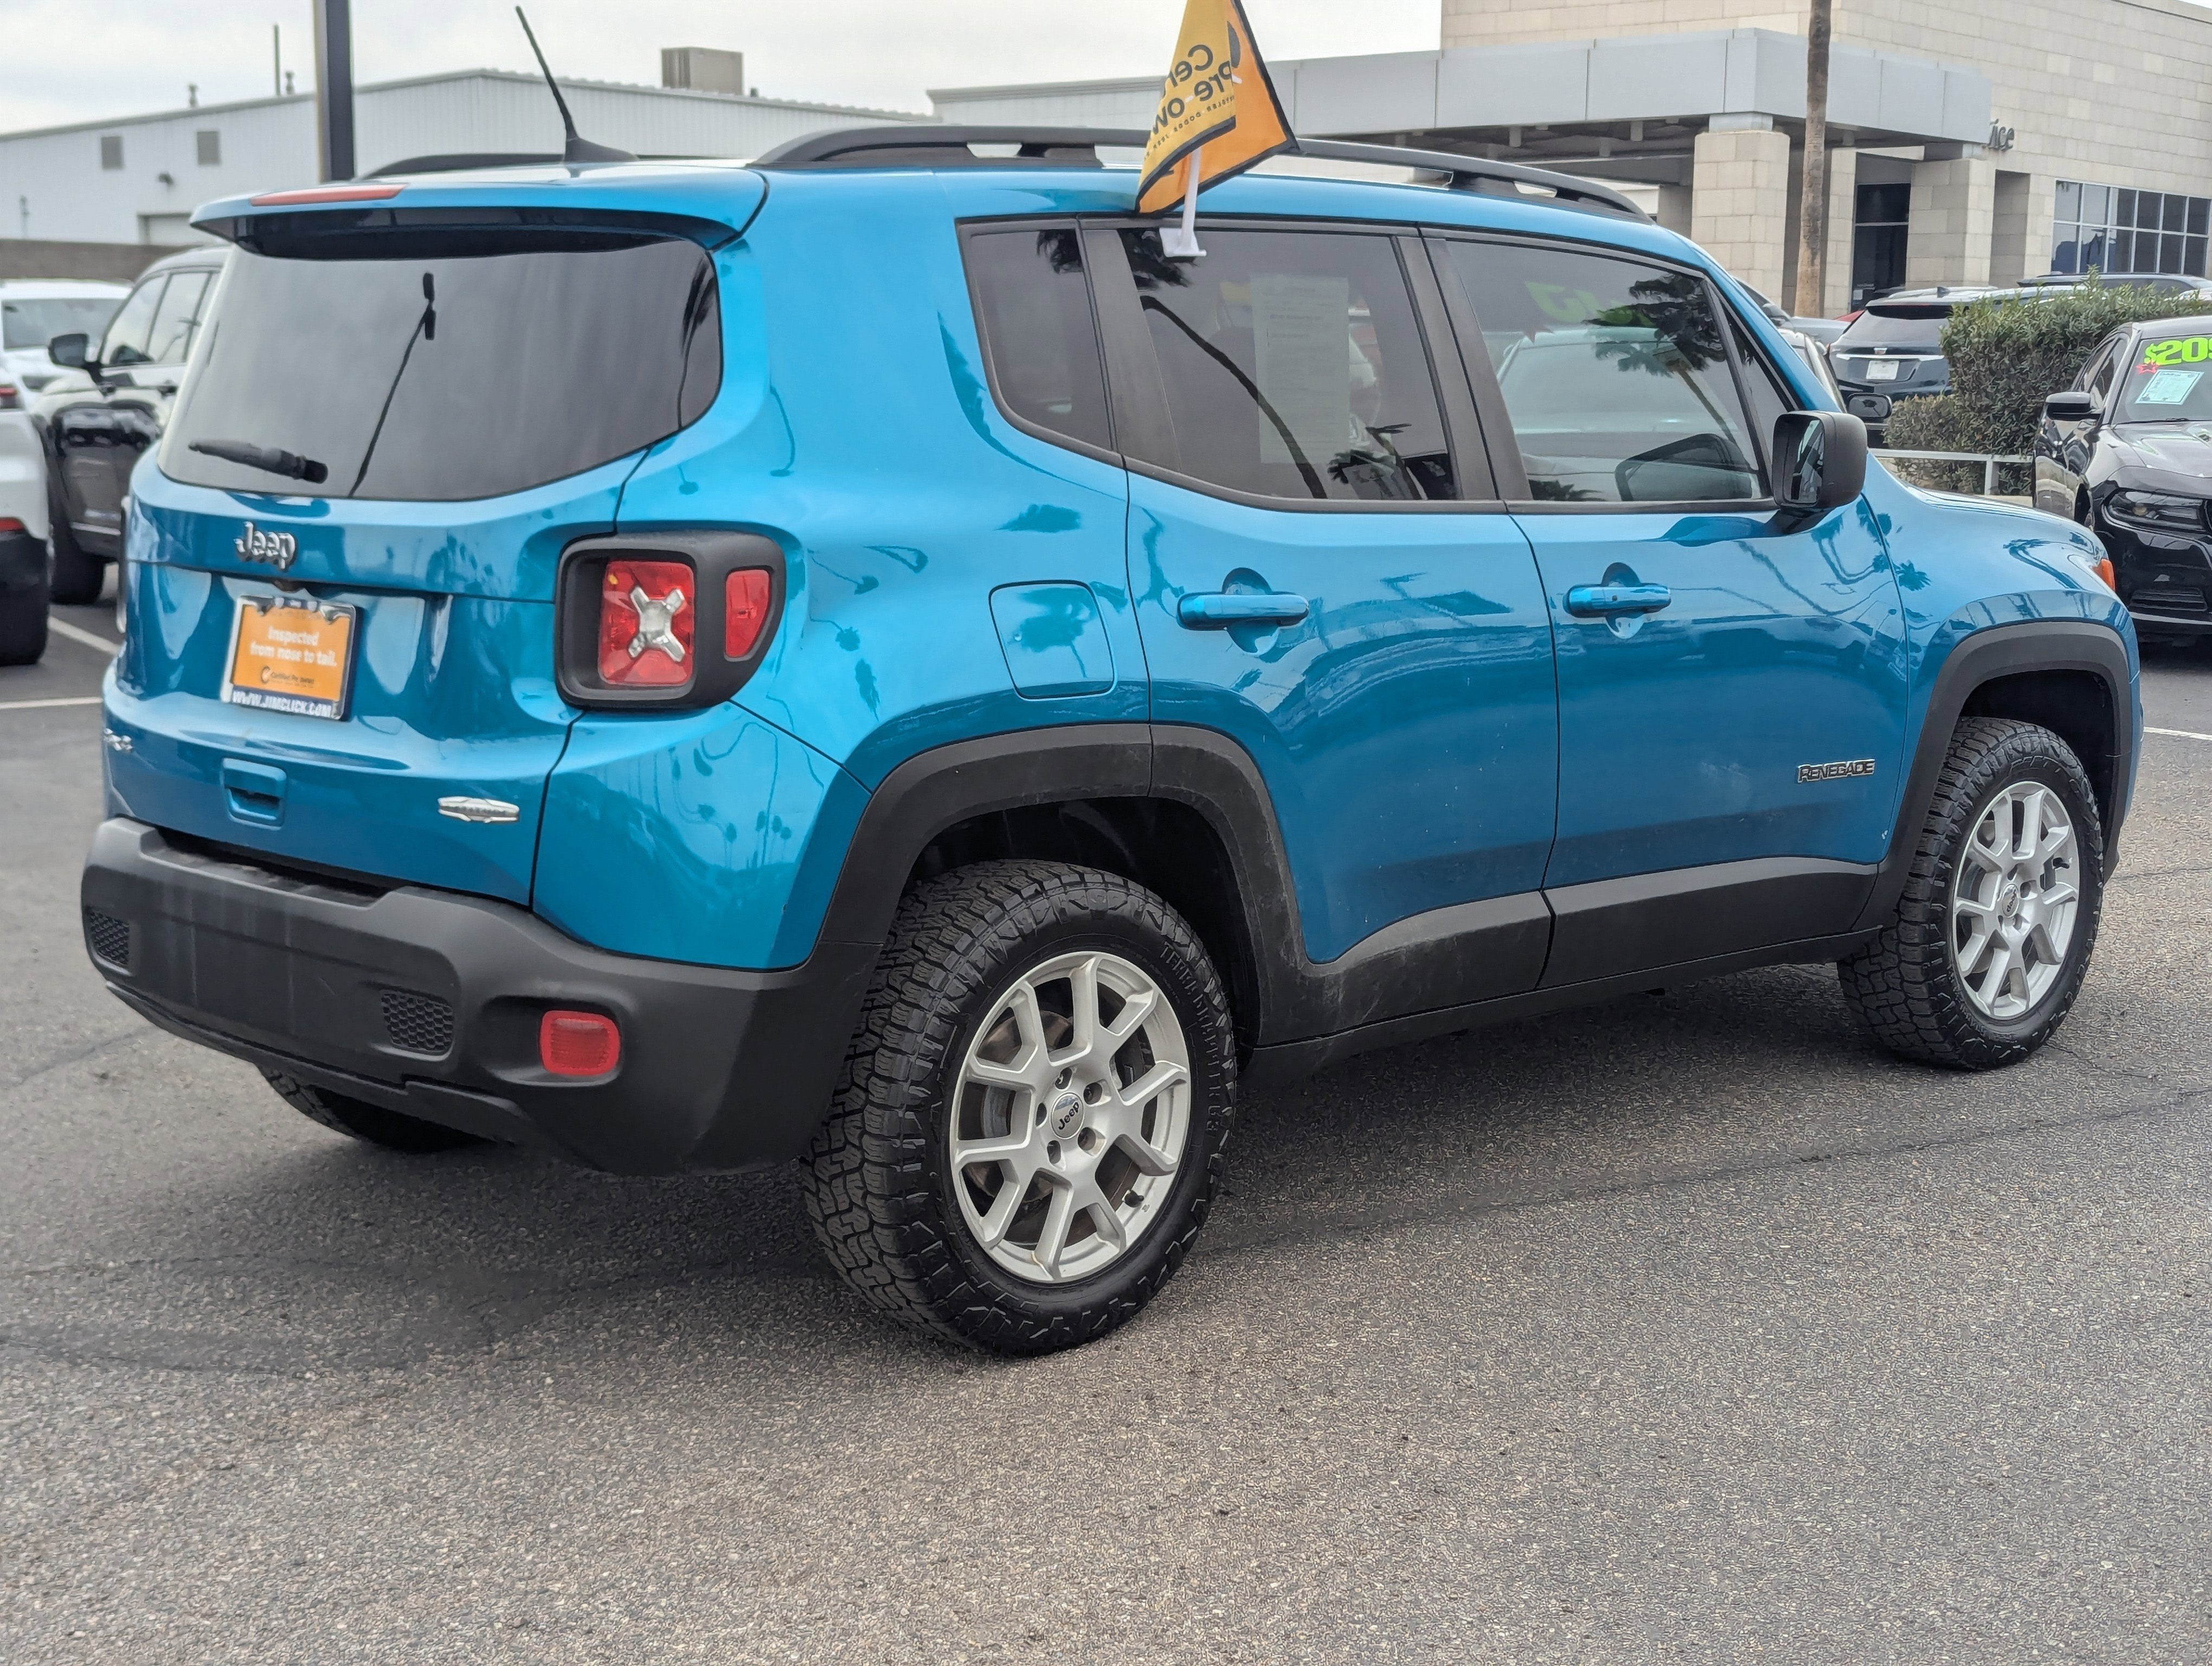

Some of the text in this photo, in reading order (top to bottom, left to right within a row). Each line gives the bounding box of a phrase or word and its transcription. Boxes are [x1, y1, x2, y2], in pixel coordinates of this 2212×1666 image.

[2144, 336, 2212, 366] $20
[233, 521, 296, 570] Jeep
[268, 626, 319, 646] Inspected
[250, 640, 274, 657] from
[304, 649, 314, 663] to
[1797, 759, 1876, 783] RENEGADE
[1058, 1101, 1079, 1130] Jeep
